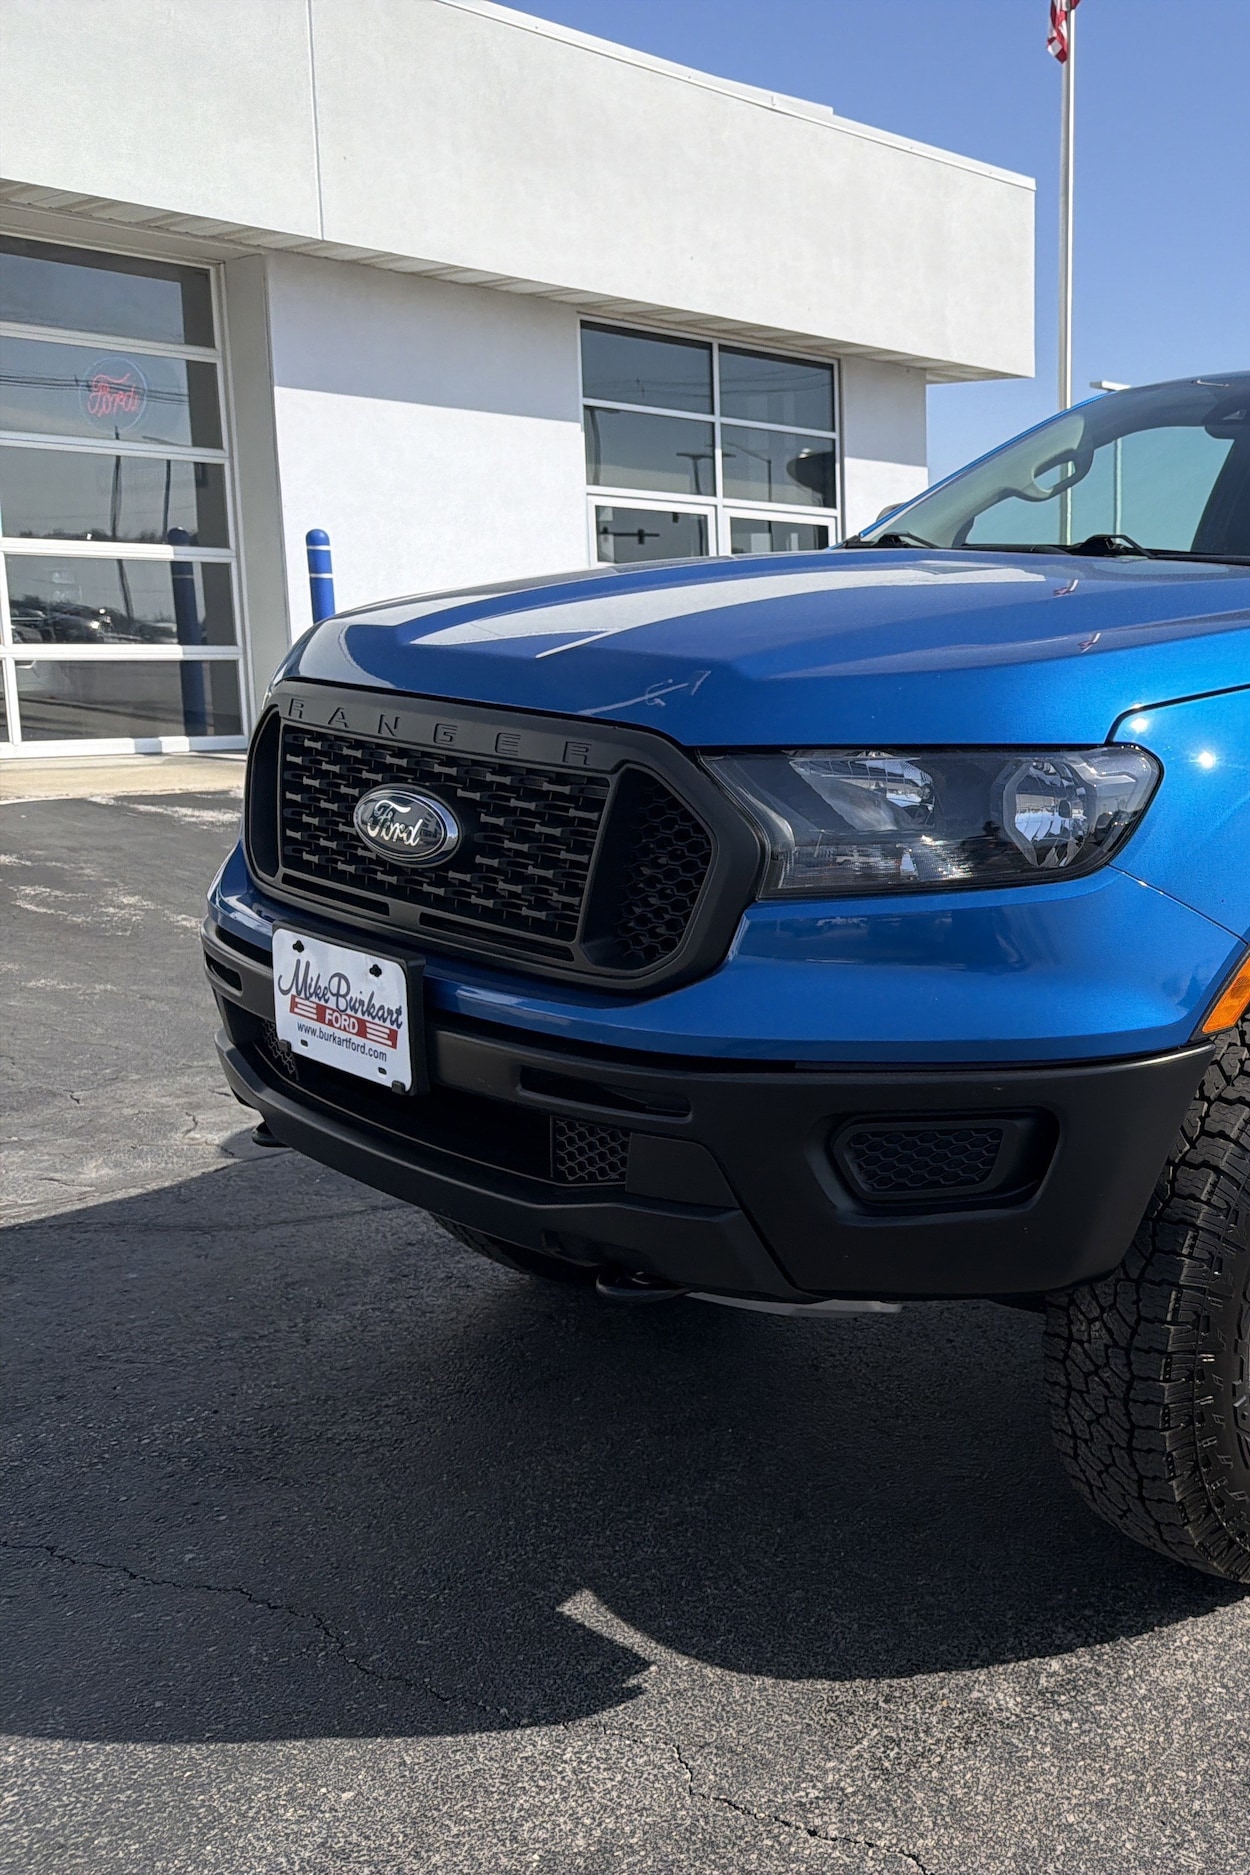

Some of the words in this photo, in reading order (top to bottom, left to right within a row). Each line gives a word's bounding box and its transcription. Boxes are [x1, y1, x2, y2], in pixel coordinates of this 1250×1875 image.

[87, 372, 139, 417] Ford
[287, 697, 593, 766] RANGER
[367, 799, 423, 847] Ford
[277, 958, 331, 1003] Mike
[328, 972, 403, 1030] Burkart
[297, 1021, 388, 1063] www.burkartford.com
[324, 1009, 359, 1034] FORD
